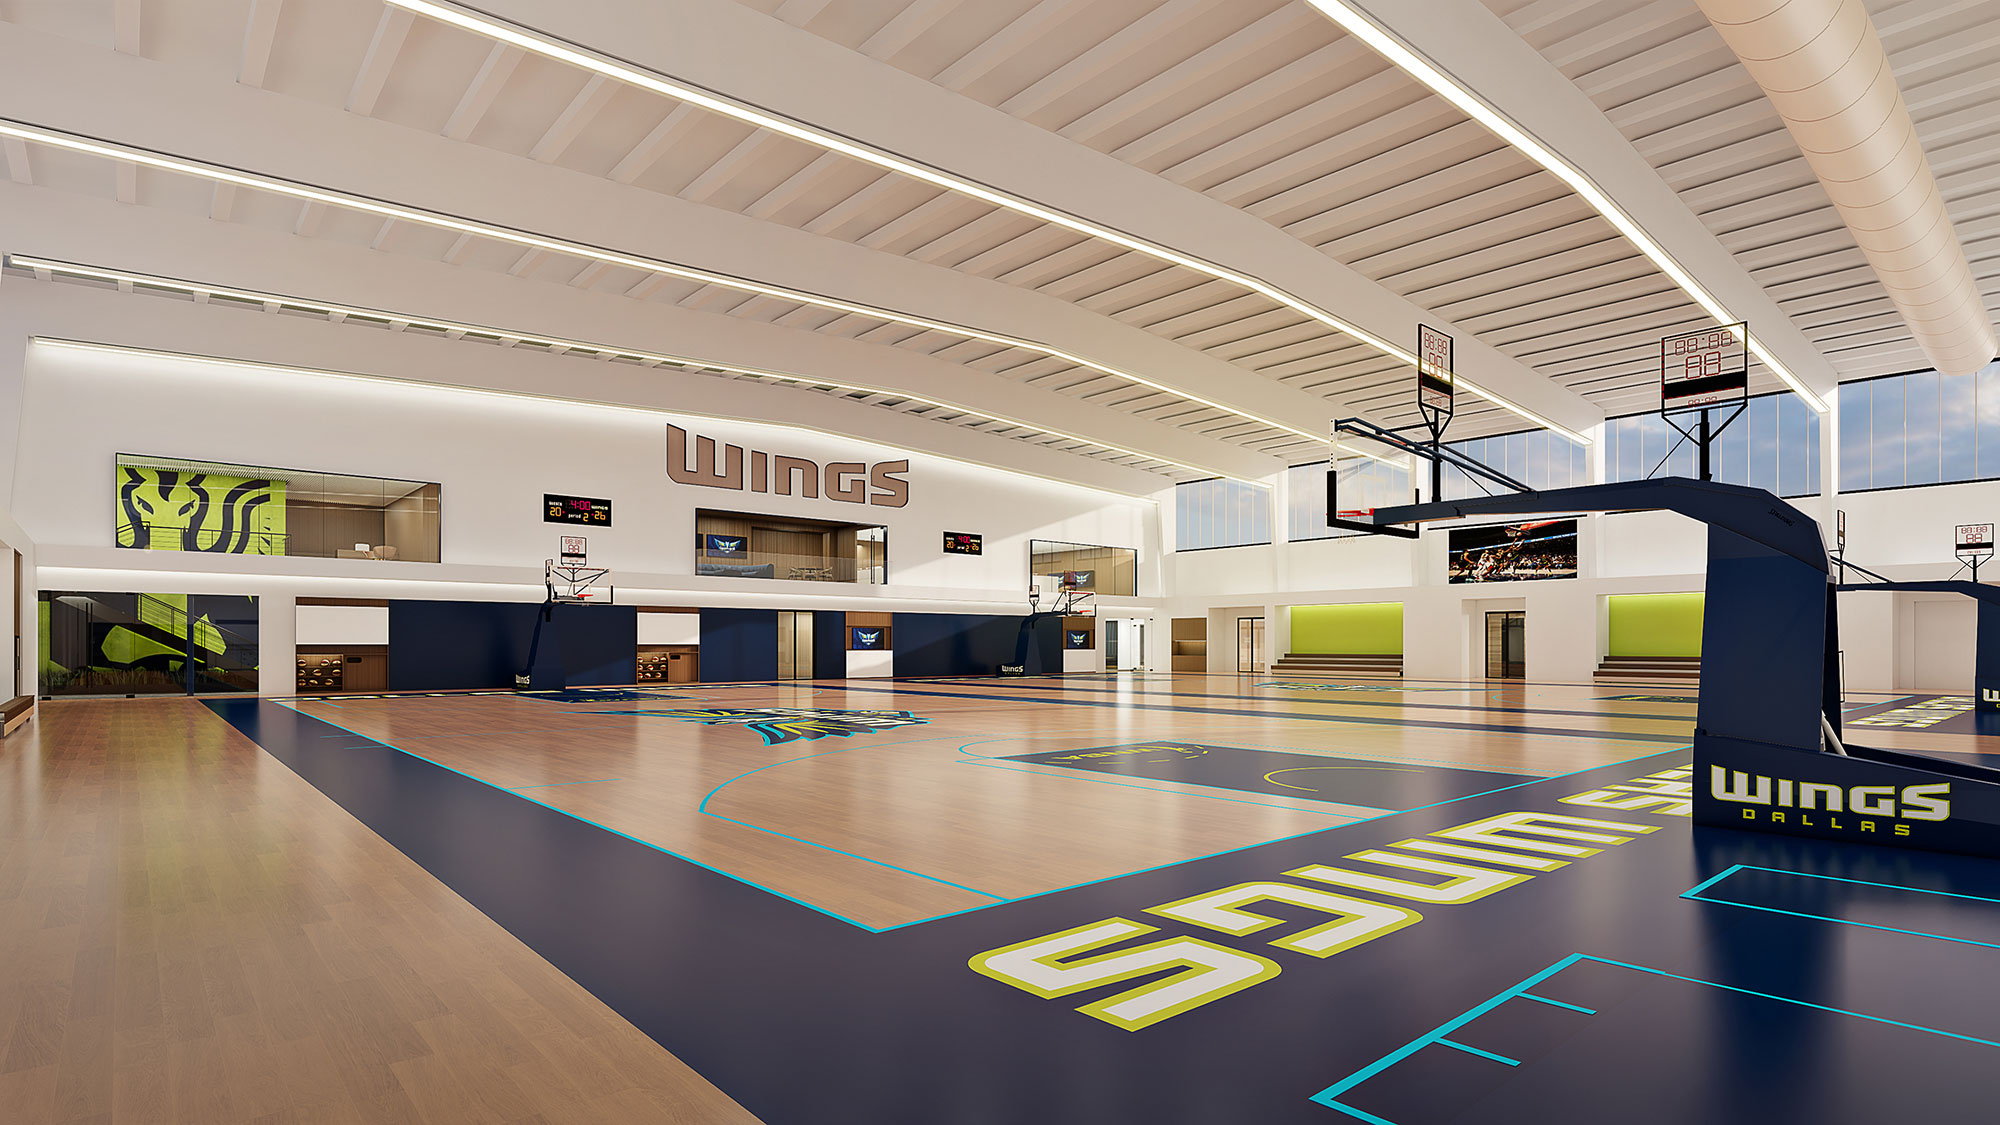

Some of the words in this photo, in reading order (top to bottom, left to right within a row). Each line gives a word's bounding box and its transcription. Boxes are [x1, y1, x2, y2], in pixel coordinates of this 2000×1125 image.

[666, 423, 909, 508] WINGS
[571, 500, 591, 511] 4:00
[549, 506, 562, 517] 20
[583, 512, 589, 522] 2
[594, 510, 606, 521] 26
[1002, 664, 1024, 673] WINGS
[1711, 764, 1950, 822] WINGS
[1743, 808, 1910, 836] DALLAS
[968, 811, 1663, 1033] WINGS
